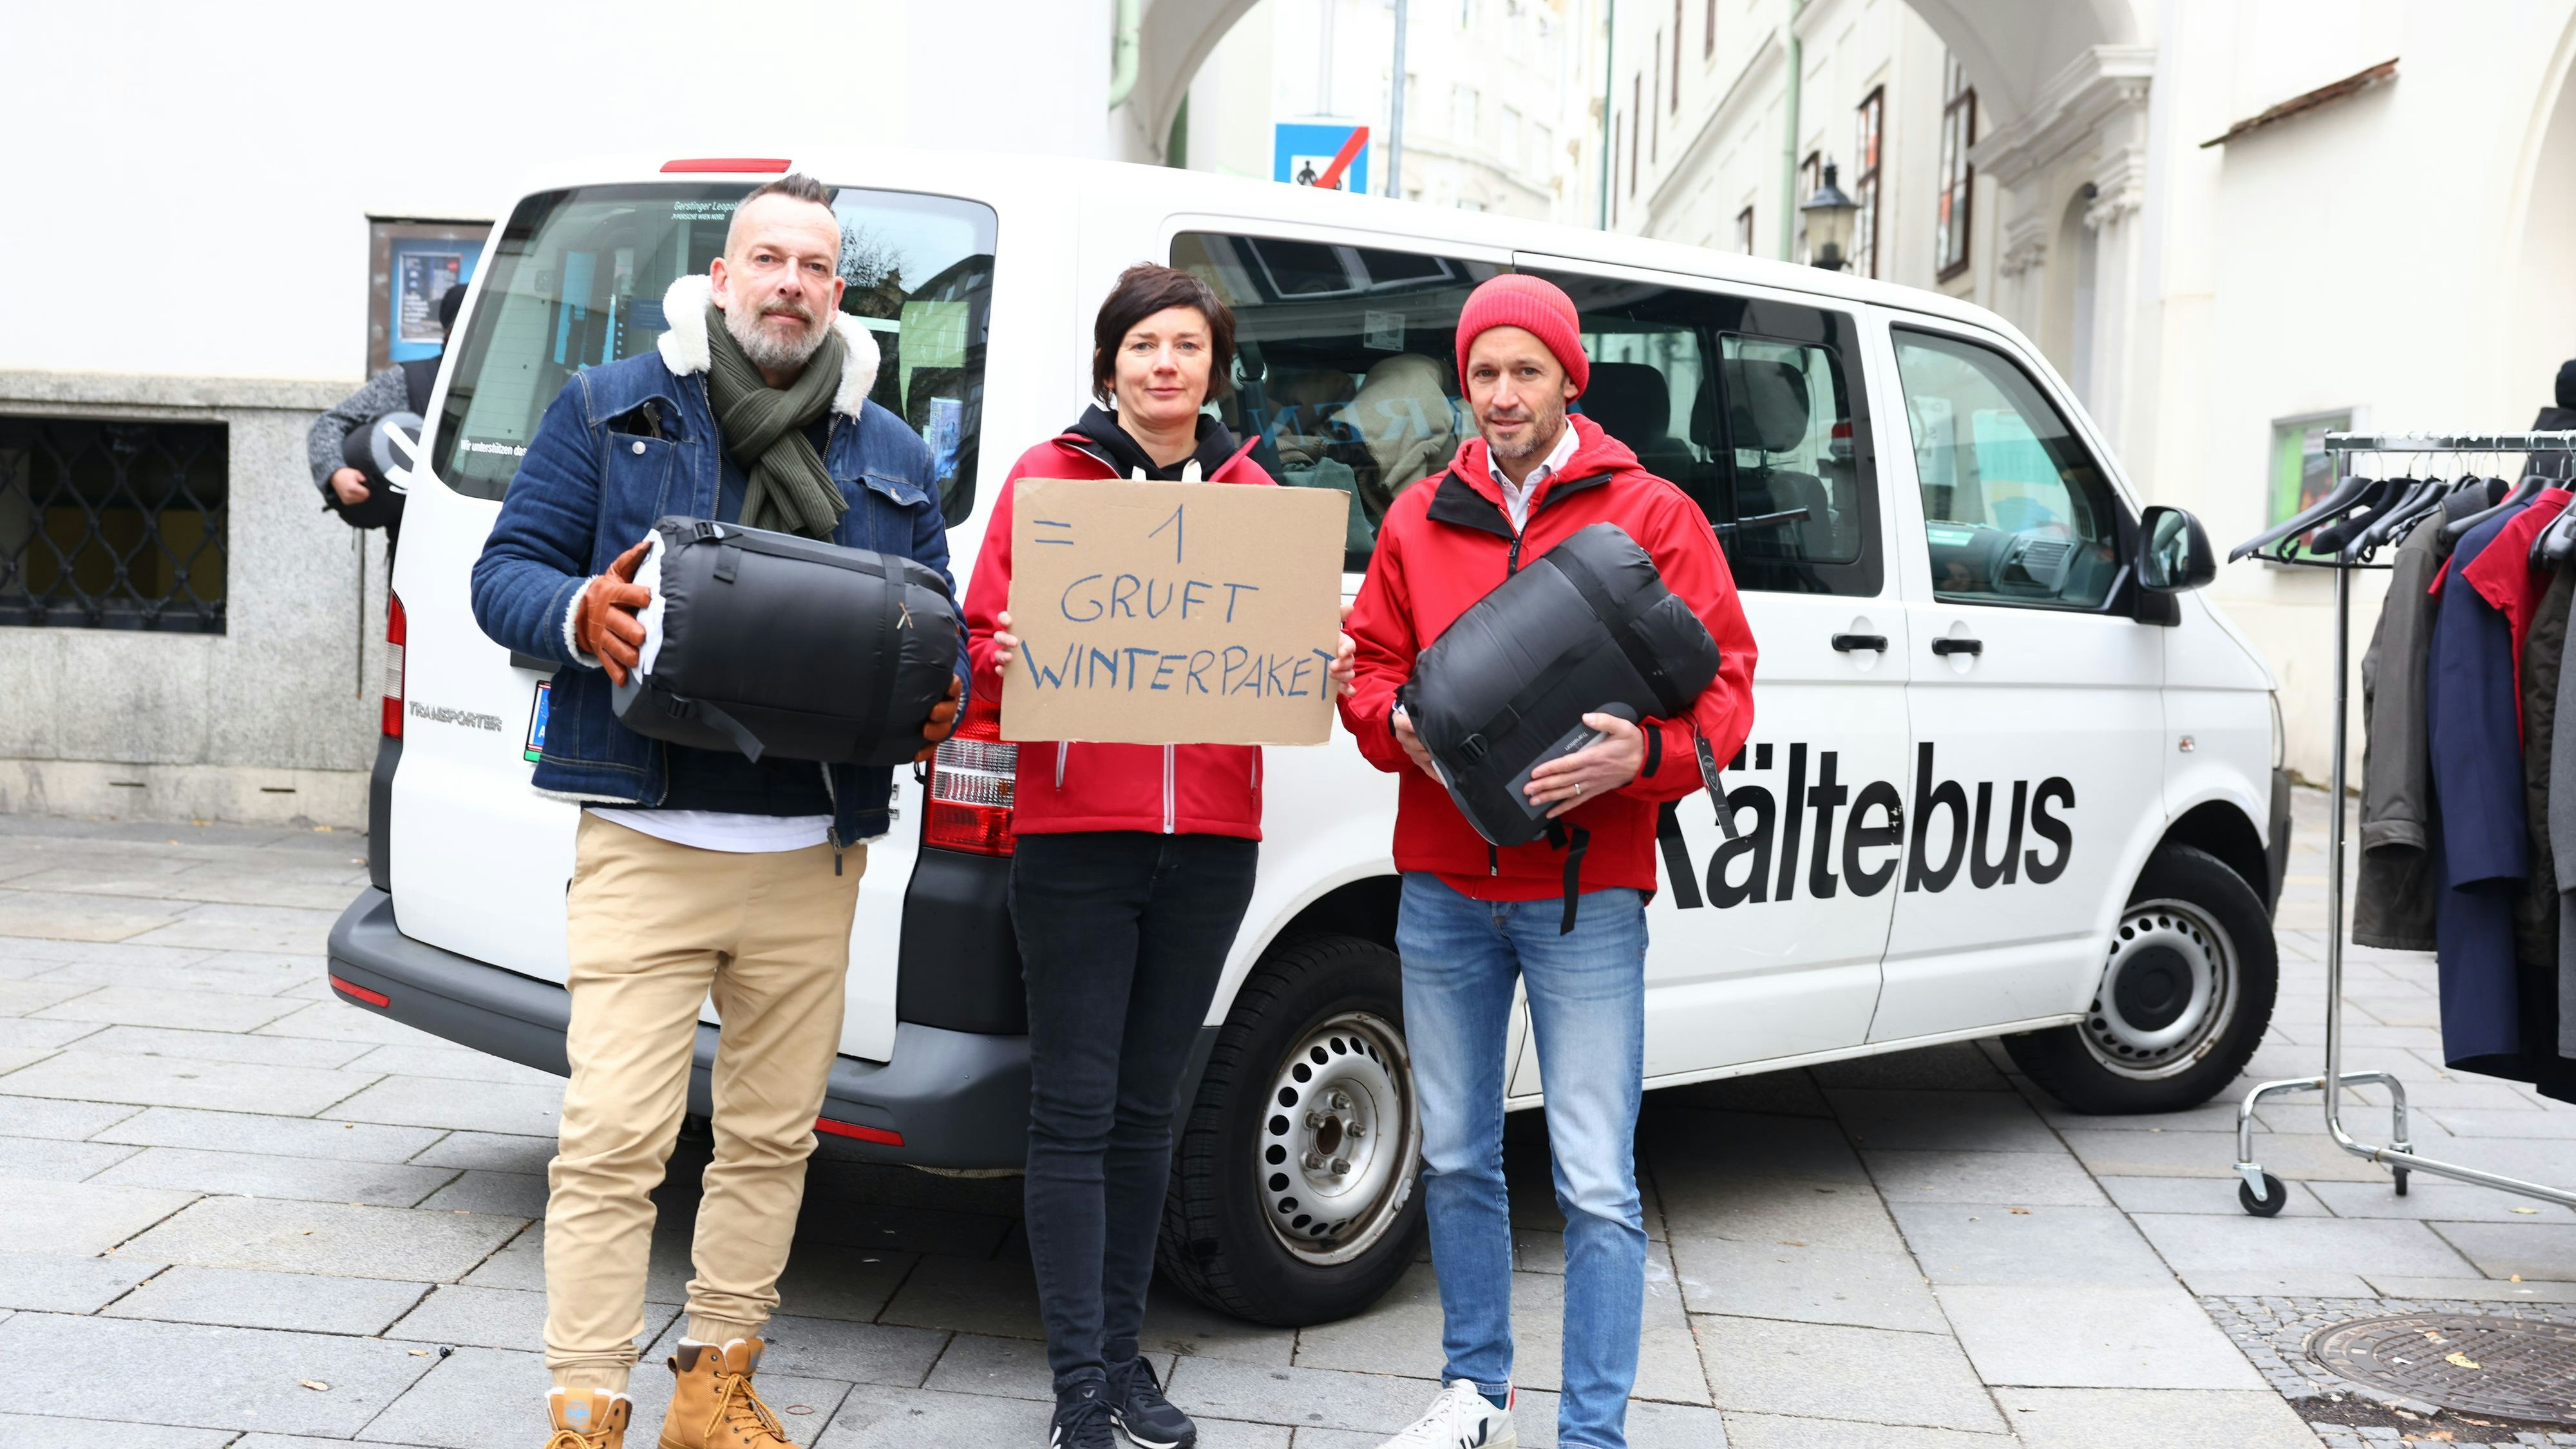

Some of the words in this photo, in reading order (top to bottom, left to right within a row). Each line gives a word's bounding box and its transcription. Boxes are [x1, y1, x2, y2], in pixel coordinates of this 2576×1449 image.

[460, 439, 471, 451] Wir
[471, 440, 513, 455] unterstützen
[1148, 503, 1184, 564] 1
[1061, 573, 1260, 623] GRUFT
[1021, 639, 1336, 701] WINTERPAKET
[409, 700, 502, 732] TRANSPORTER
